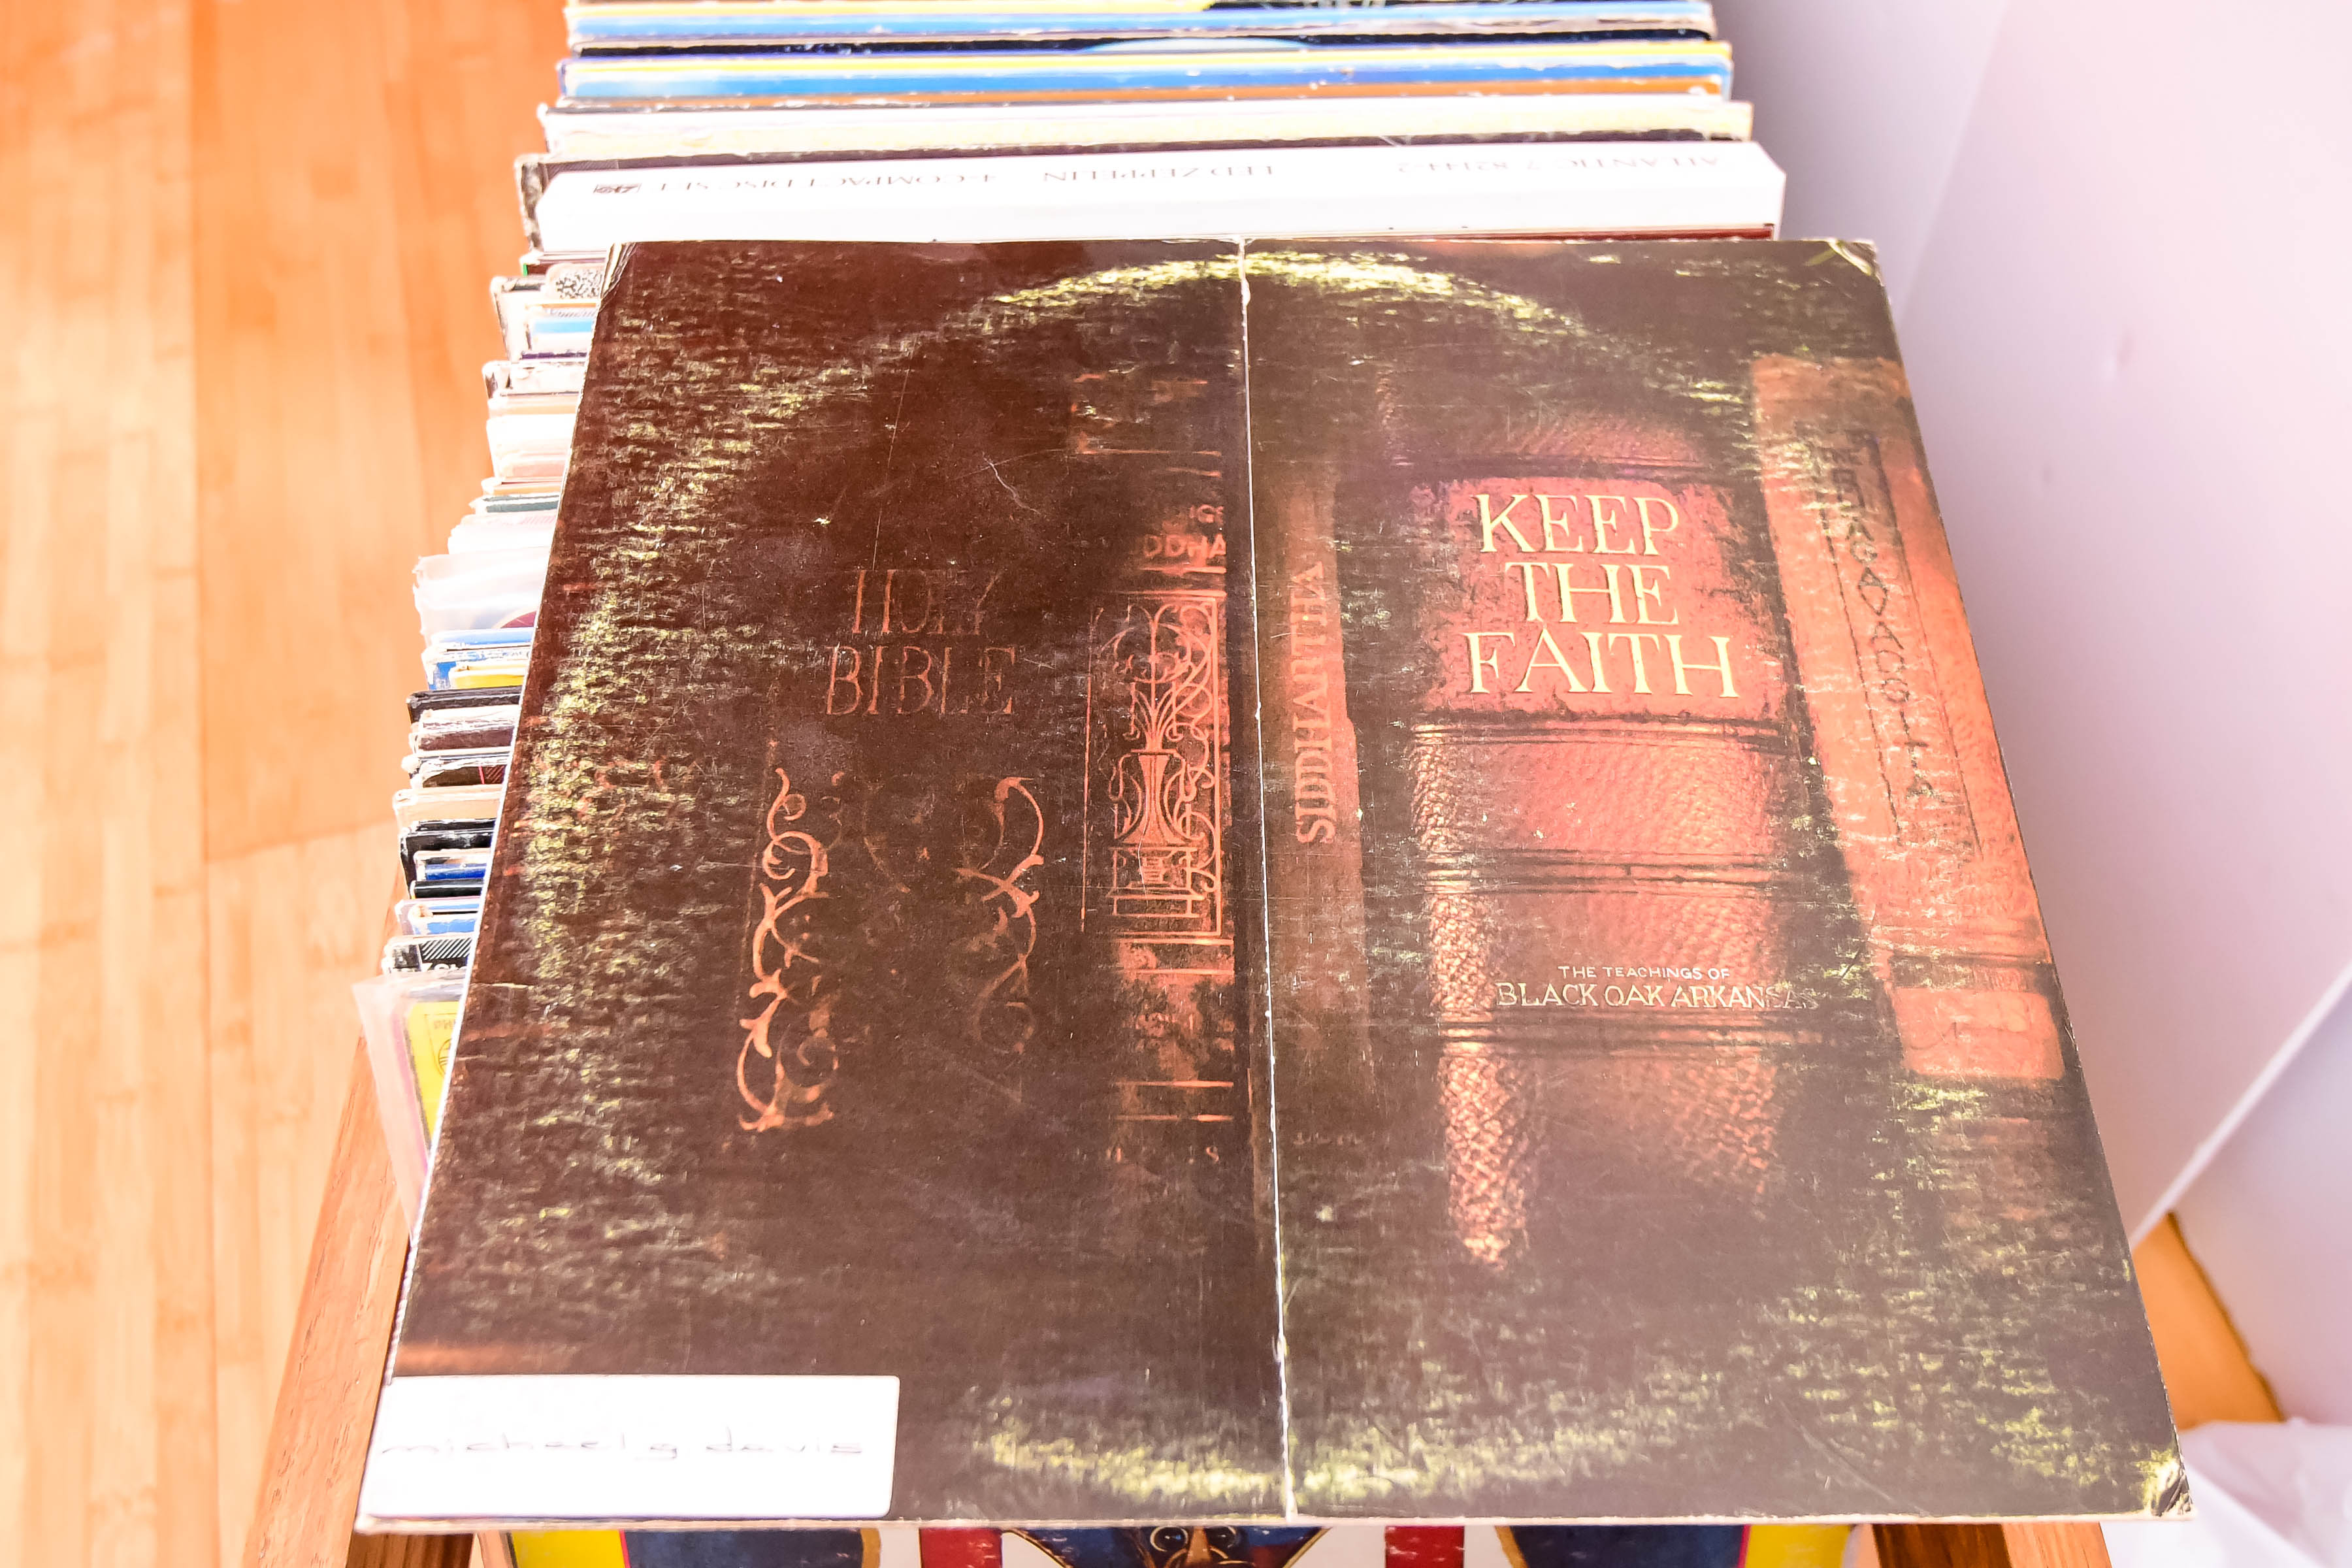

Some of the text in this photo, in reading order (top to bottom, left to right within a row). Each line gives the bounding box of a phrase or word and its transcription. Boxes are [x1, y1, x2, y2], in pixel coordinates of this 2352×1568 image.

[1043, 168, 1199, 182] ZEPPELIN
[1471, 494, 1679, 556] KEEP
[1505, 561, 1679, 625] THE
[824, 645, 1016, 716] BIBLE
[1462, 622, 1740, 698] FAITH
[1290, 561, 1337, 844] SIDDHARTHA
[1495, 981, 1821, 1010] BLACK OAK ARKANSAS
[1558, 965, 1731, 981] THE TEACHINGS OF
[704, 1425, 864, 1455] davis
